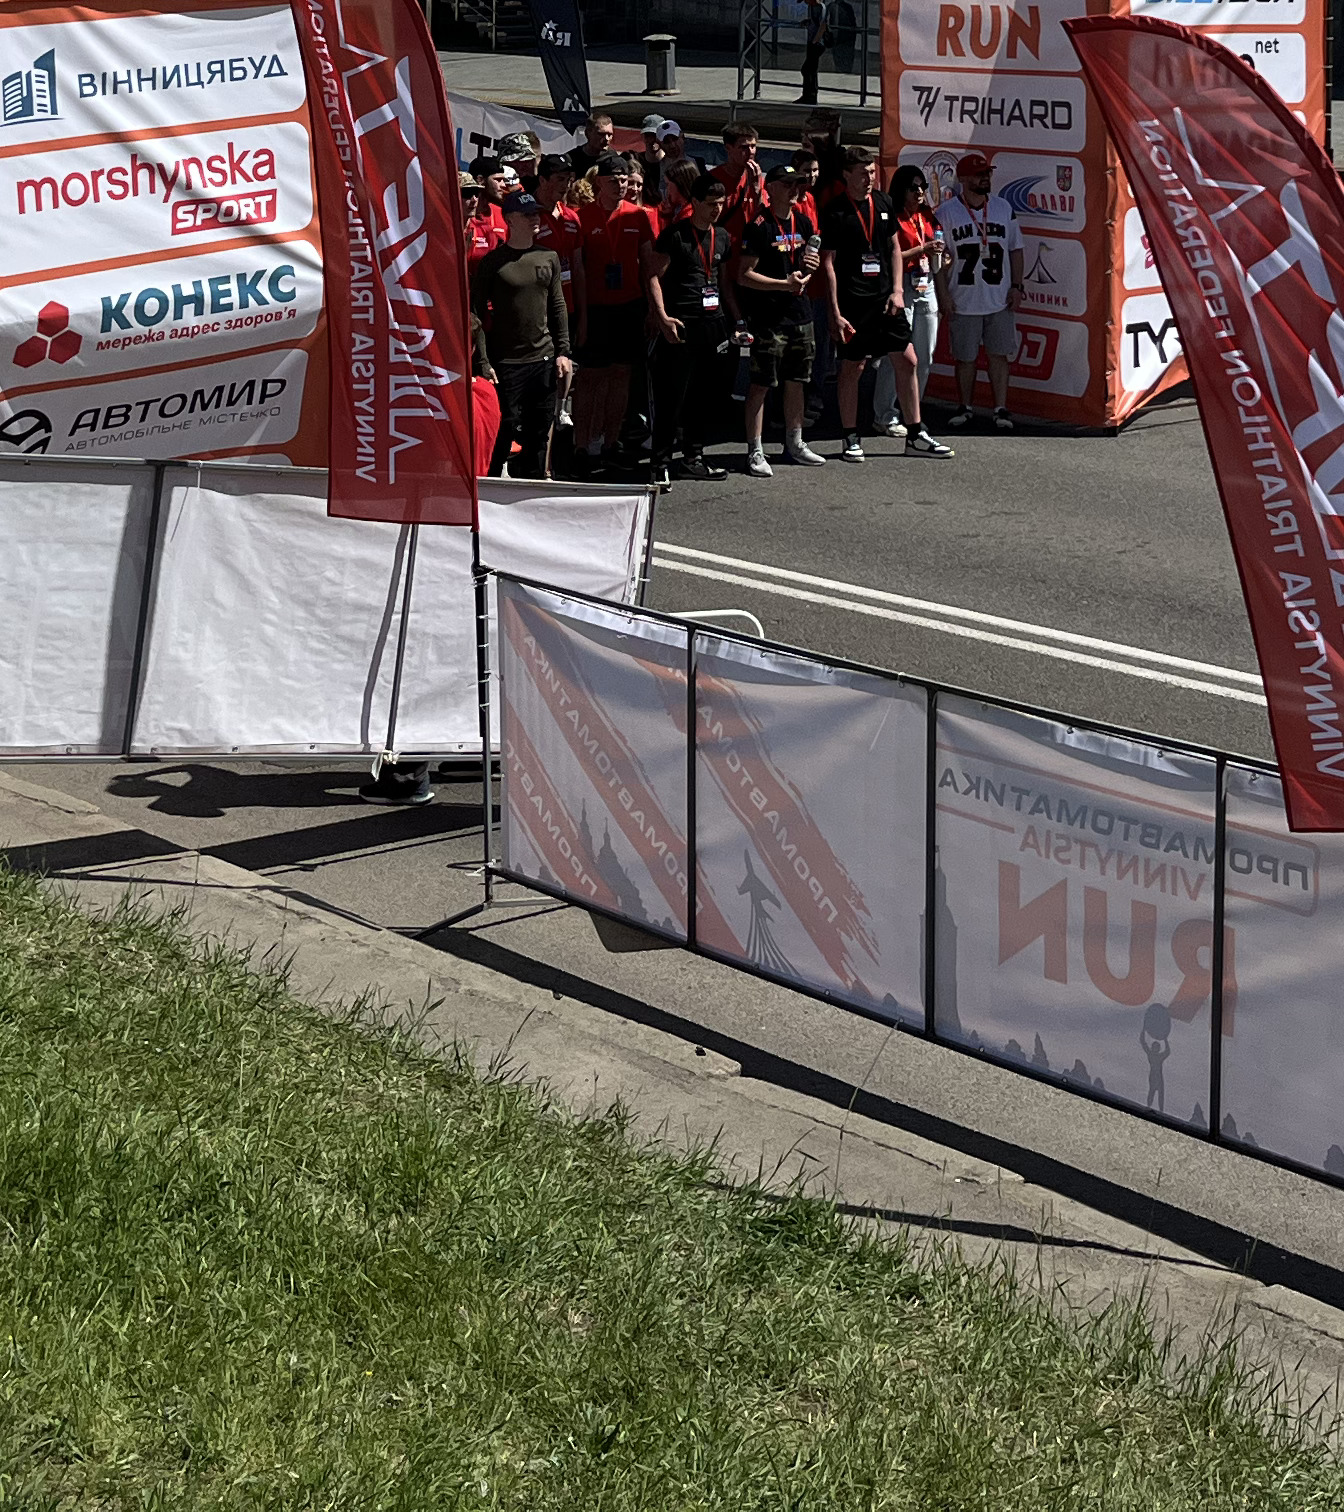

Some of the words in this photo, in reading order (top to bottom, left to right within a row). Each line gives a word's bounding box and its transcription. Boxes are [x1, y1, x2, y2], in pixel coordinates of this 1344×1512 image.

[937, 4, 1041, 61] RUN
[1255, 38, 1280, 53] net
[77, 53, 288, 99] ВІННИЦЯБУД
[944, 94, 1072, 130] TRIHARD
[16, 141, 277, 215] morshynska
[175, 193, 273, 232] SPORT
[99, 264, 297, 333] КОНЕКС
[1022, 290, 1068, 307] ОЧІВНИК
[95, 329, 165, 351] мережа
[169, 320, 220, 340] адрес
[1126, 318, 1184, 368] TY
[64, 418, 192, 452] АВТОМОБІЛЬНЕ
[198, 406, 281, 429] МІСТЕЧКО
[67, 378, 287, 437] АВТОМИР
